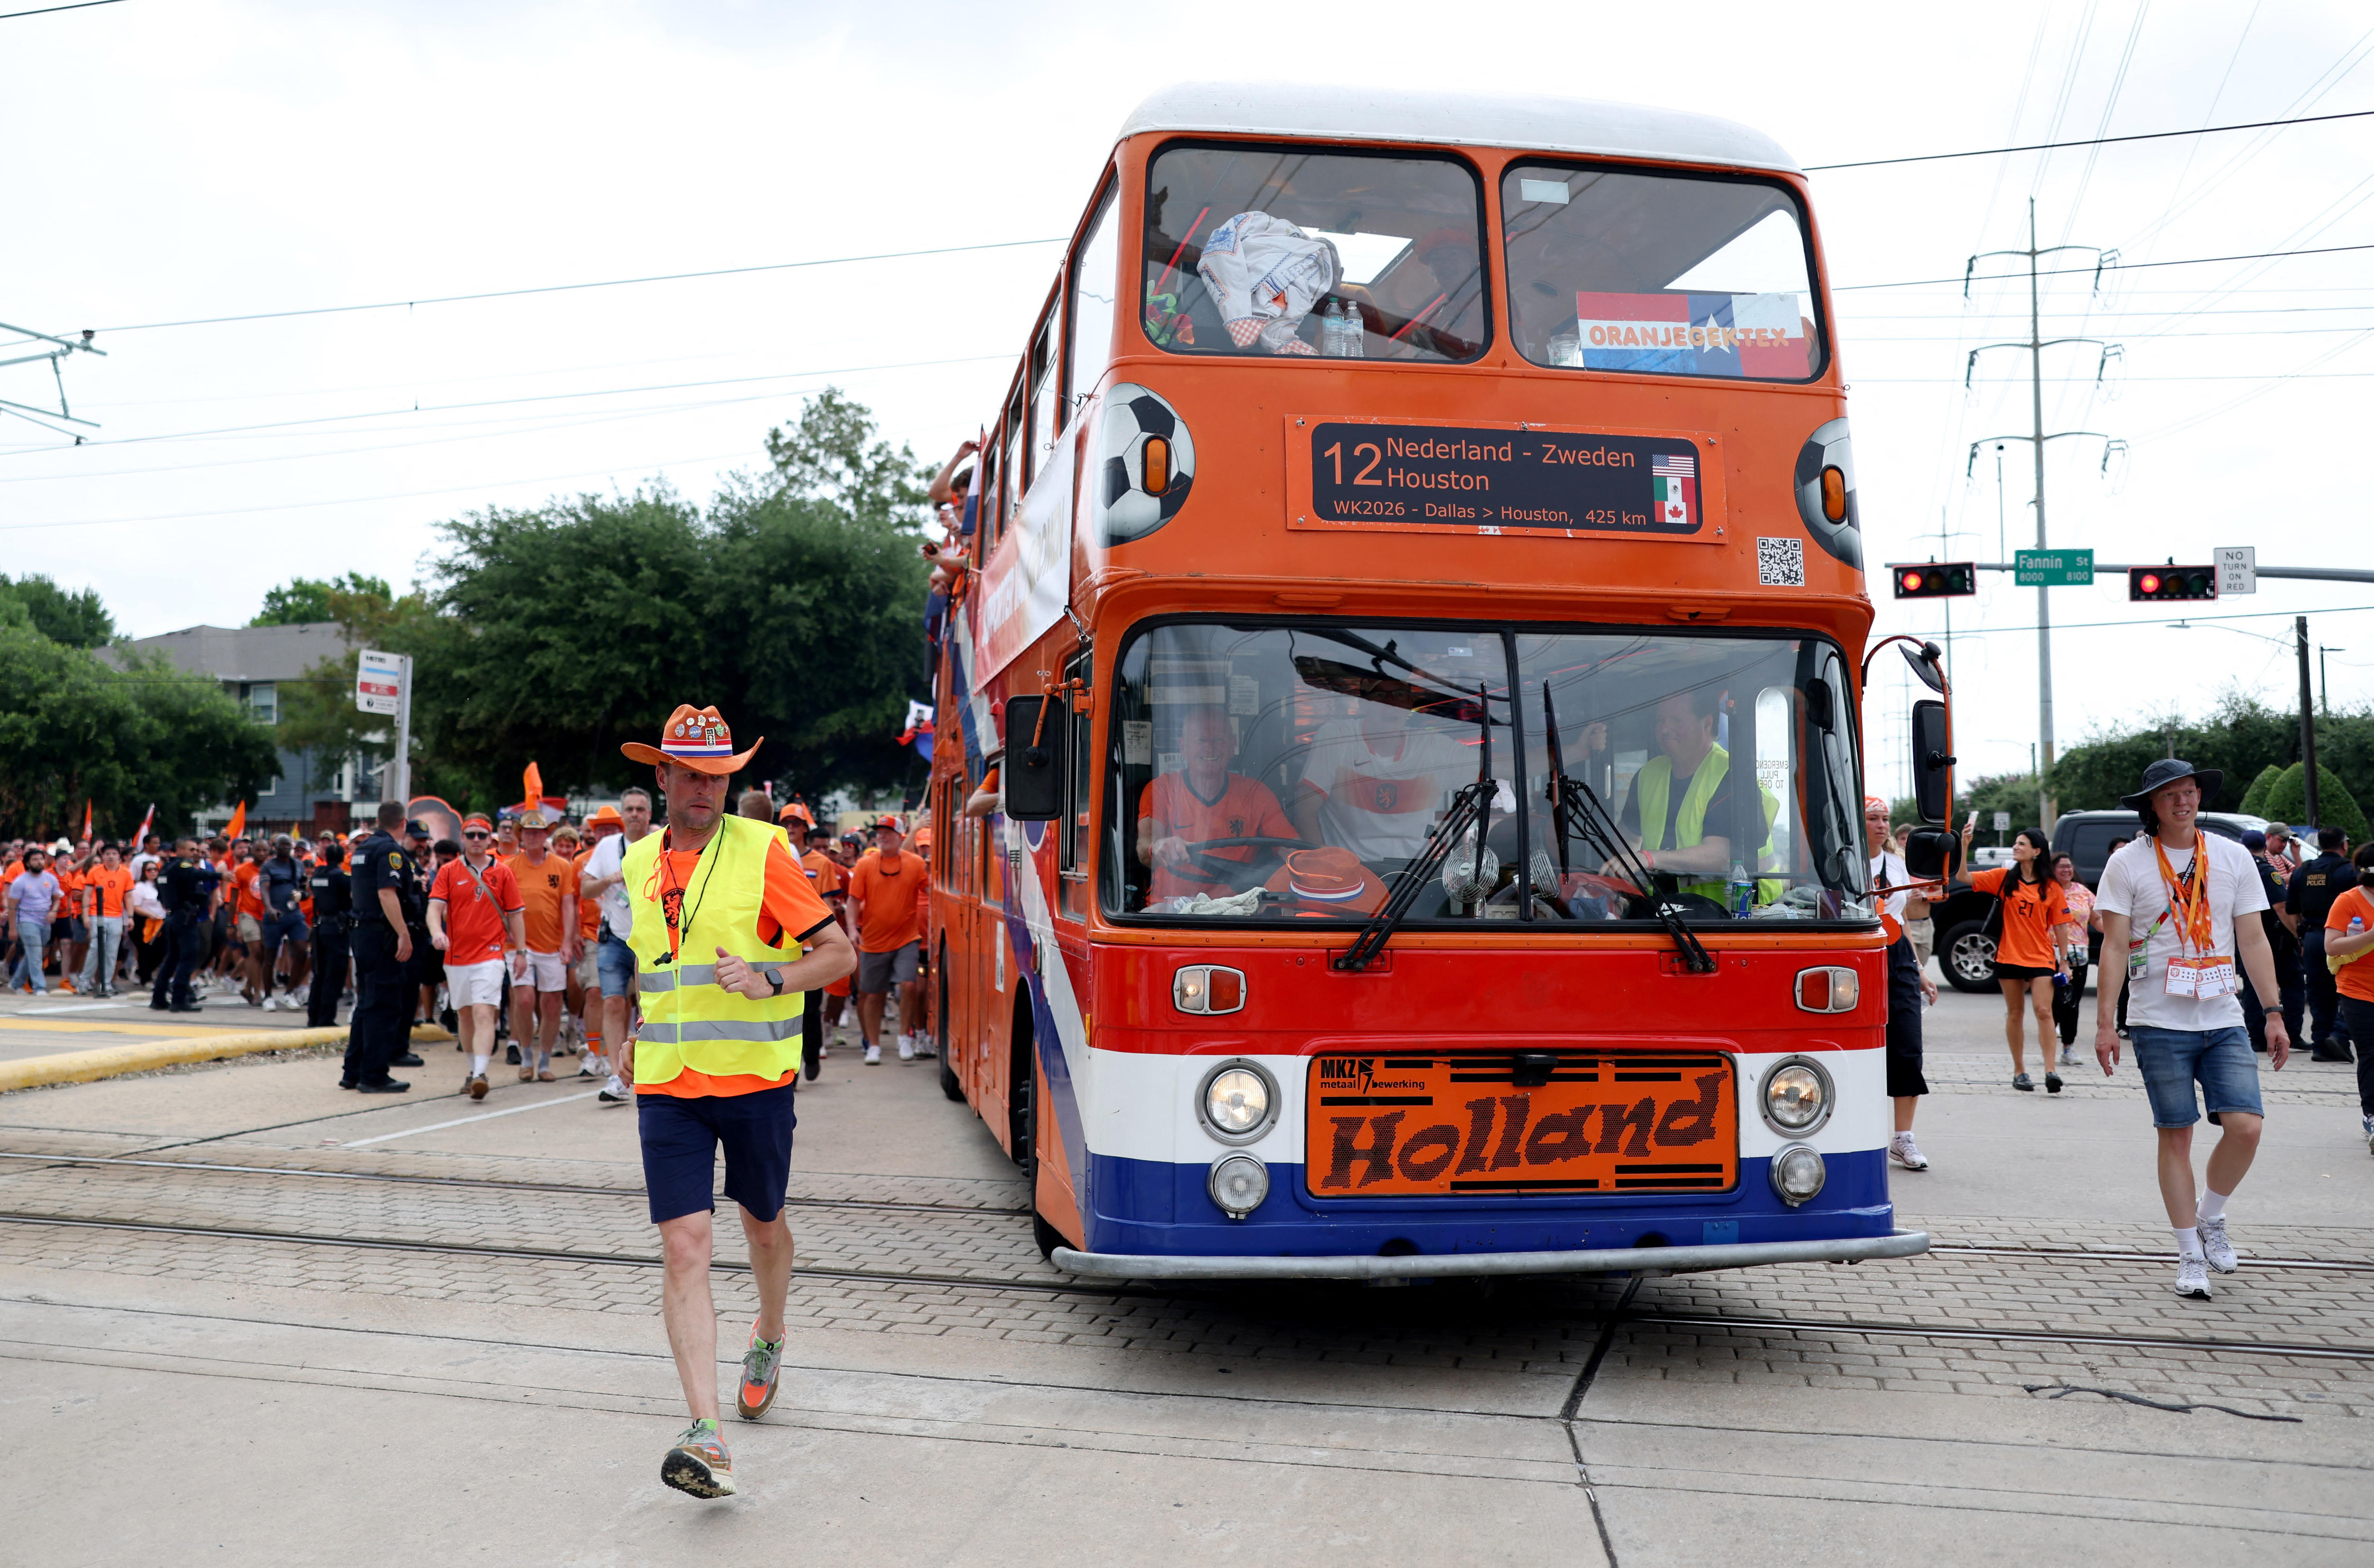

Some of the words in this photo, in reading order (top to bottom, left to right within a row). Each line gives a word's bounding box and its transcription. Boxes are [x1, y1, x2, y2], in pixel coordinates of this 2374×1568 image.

[1387, 437, 1513, 461] Nederland
[1542, 443, 1635, 468] Zweden
[1324, 442, 1383, 486] 12
[1387, 468, 1490, 491] Houston
[1333, 500, 1406, 516] WK2026
[1425, 502, 1476, 518] Dallas
[1501, 506, 1574, 525] Houston,
[1585, 509, 1616, 524] 425
[1622, 510, 1647, 525] km
[2019, 555, 2063, 569] Fannin
[2075, 557, 2089, 567] St
[2225, 552, 2243, 560] NO
[2019, 573, 2044, 582] 8000
[2066, 571, 2089, 581] 8100
[2229, 573, 2242, 581] ON
[2226, 583, 2244, 591] RED
[2185, 863, 2195, 877] WORLD
[474, 886, 483, 901] 9
[1321, 1059, 1357, 1078] MKZ
[1320, 1080, 1357, 1089] metaal
[1372, 1079, 1425, 1091] bewerking
[1321, 1070, 1729, 1189] Holland
